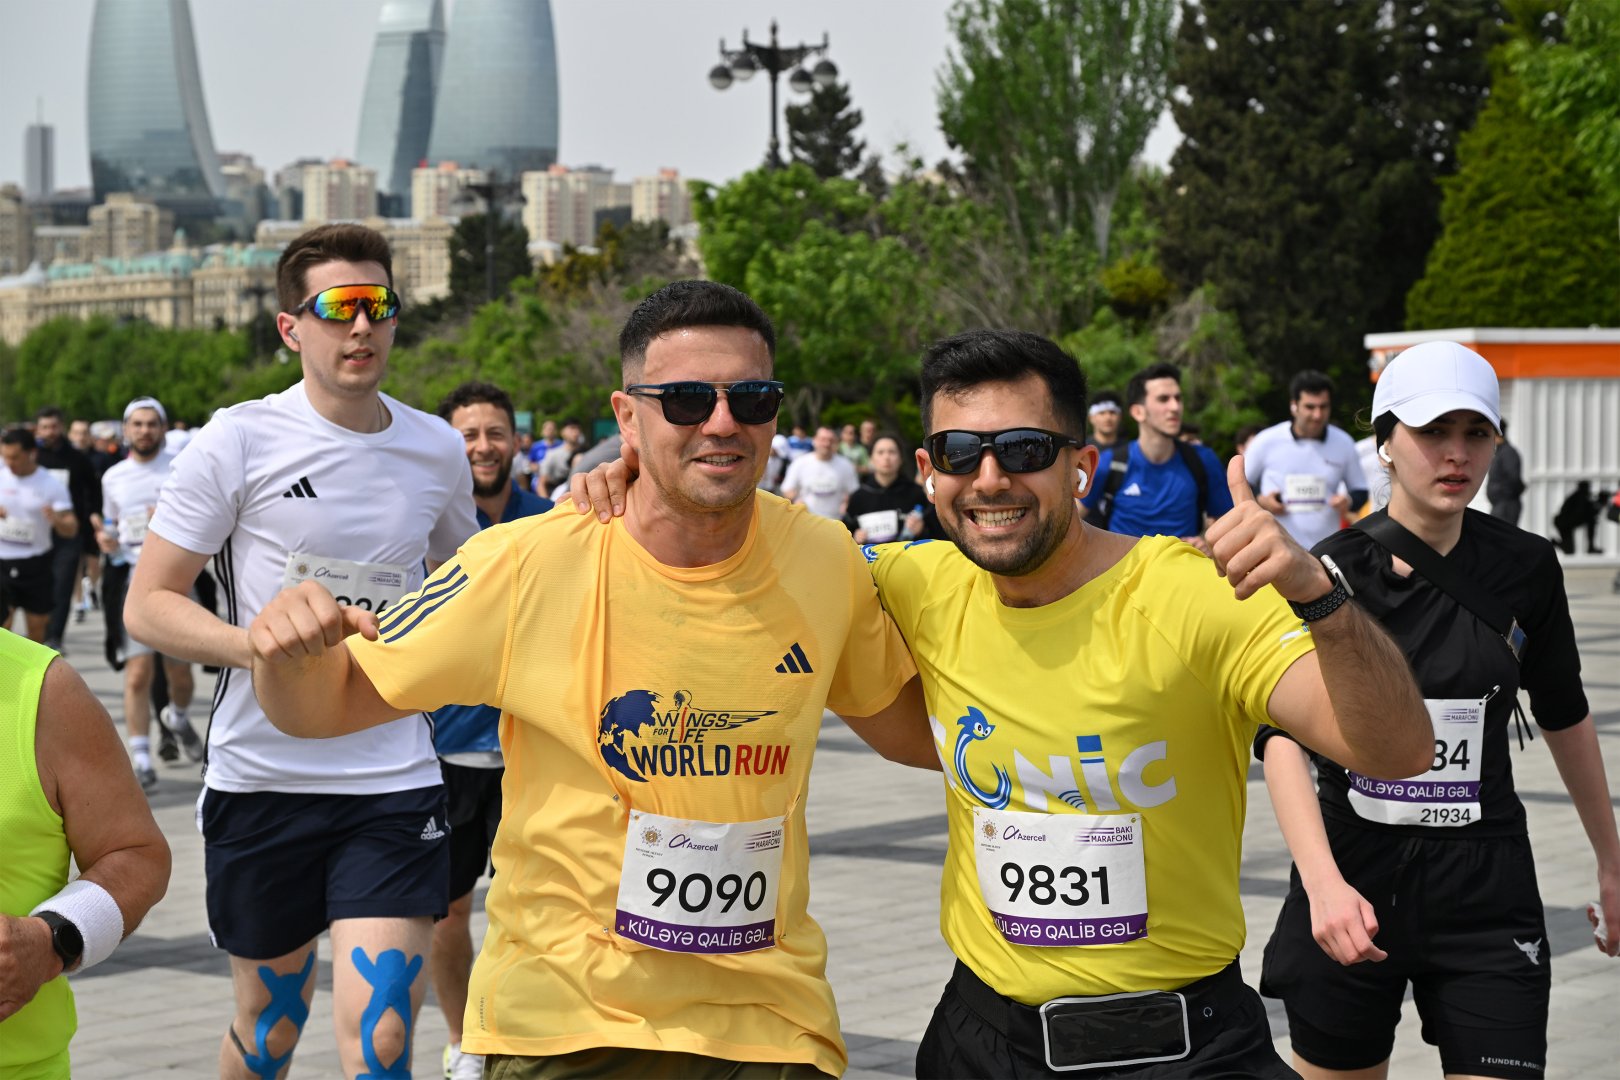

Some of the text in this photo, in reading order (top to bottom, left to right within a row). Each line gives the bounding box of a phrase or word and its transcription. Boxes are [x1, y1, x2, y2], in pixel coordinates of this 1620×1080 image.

[656, 707, 730, 728] WINGS
[653, 728, 708, 744] FOR LIFE
[631, 744, 791, 777] WORLD RUN
[1430, 739, 1470, 771] 34
[1356, 776, 1404, 796] KÜLƏYƏ
[1447, 786, 1472, 798] GƏL
[1420, 808, 1472, 823] 21934
[1017, 833, 1047, 842] Azercell
[1115, 825, 1133, 834] BAKI
[1091, 833, 1133, 843] MARAFONU
[687, 842, 719, 853] Azercell
[646, 868, 767, 913] 9090
[1000, 862, 1110, 907] 9831
[628, 919, 694, 946] KÜLƏYƏ
[744, 928, 767, 945] GƏL
[1100, 923, 1137, 938] GƏL
[1491, 1057, 1521, 1067] UNDER
